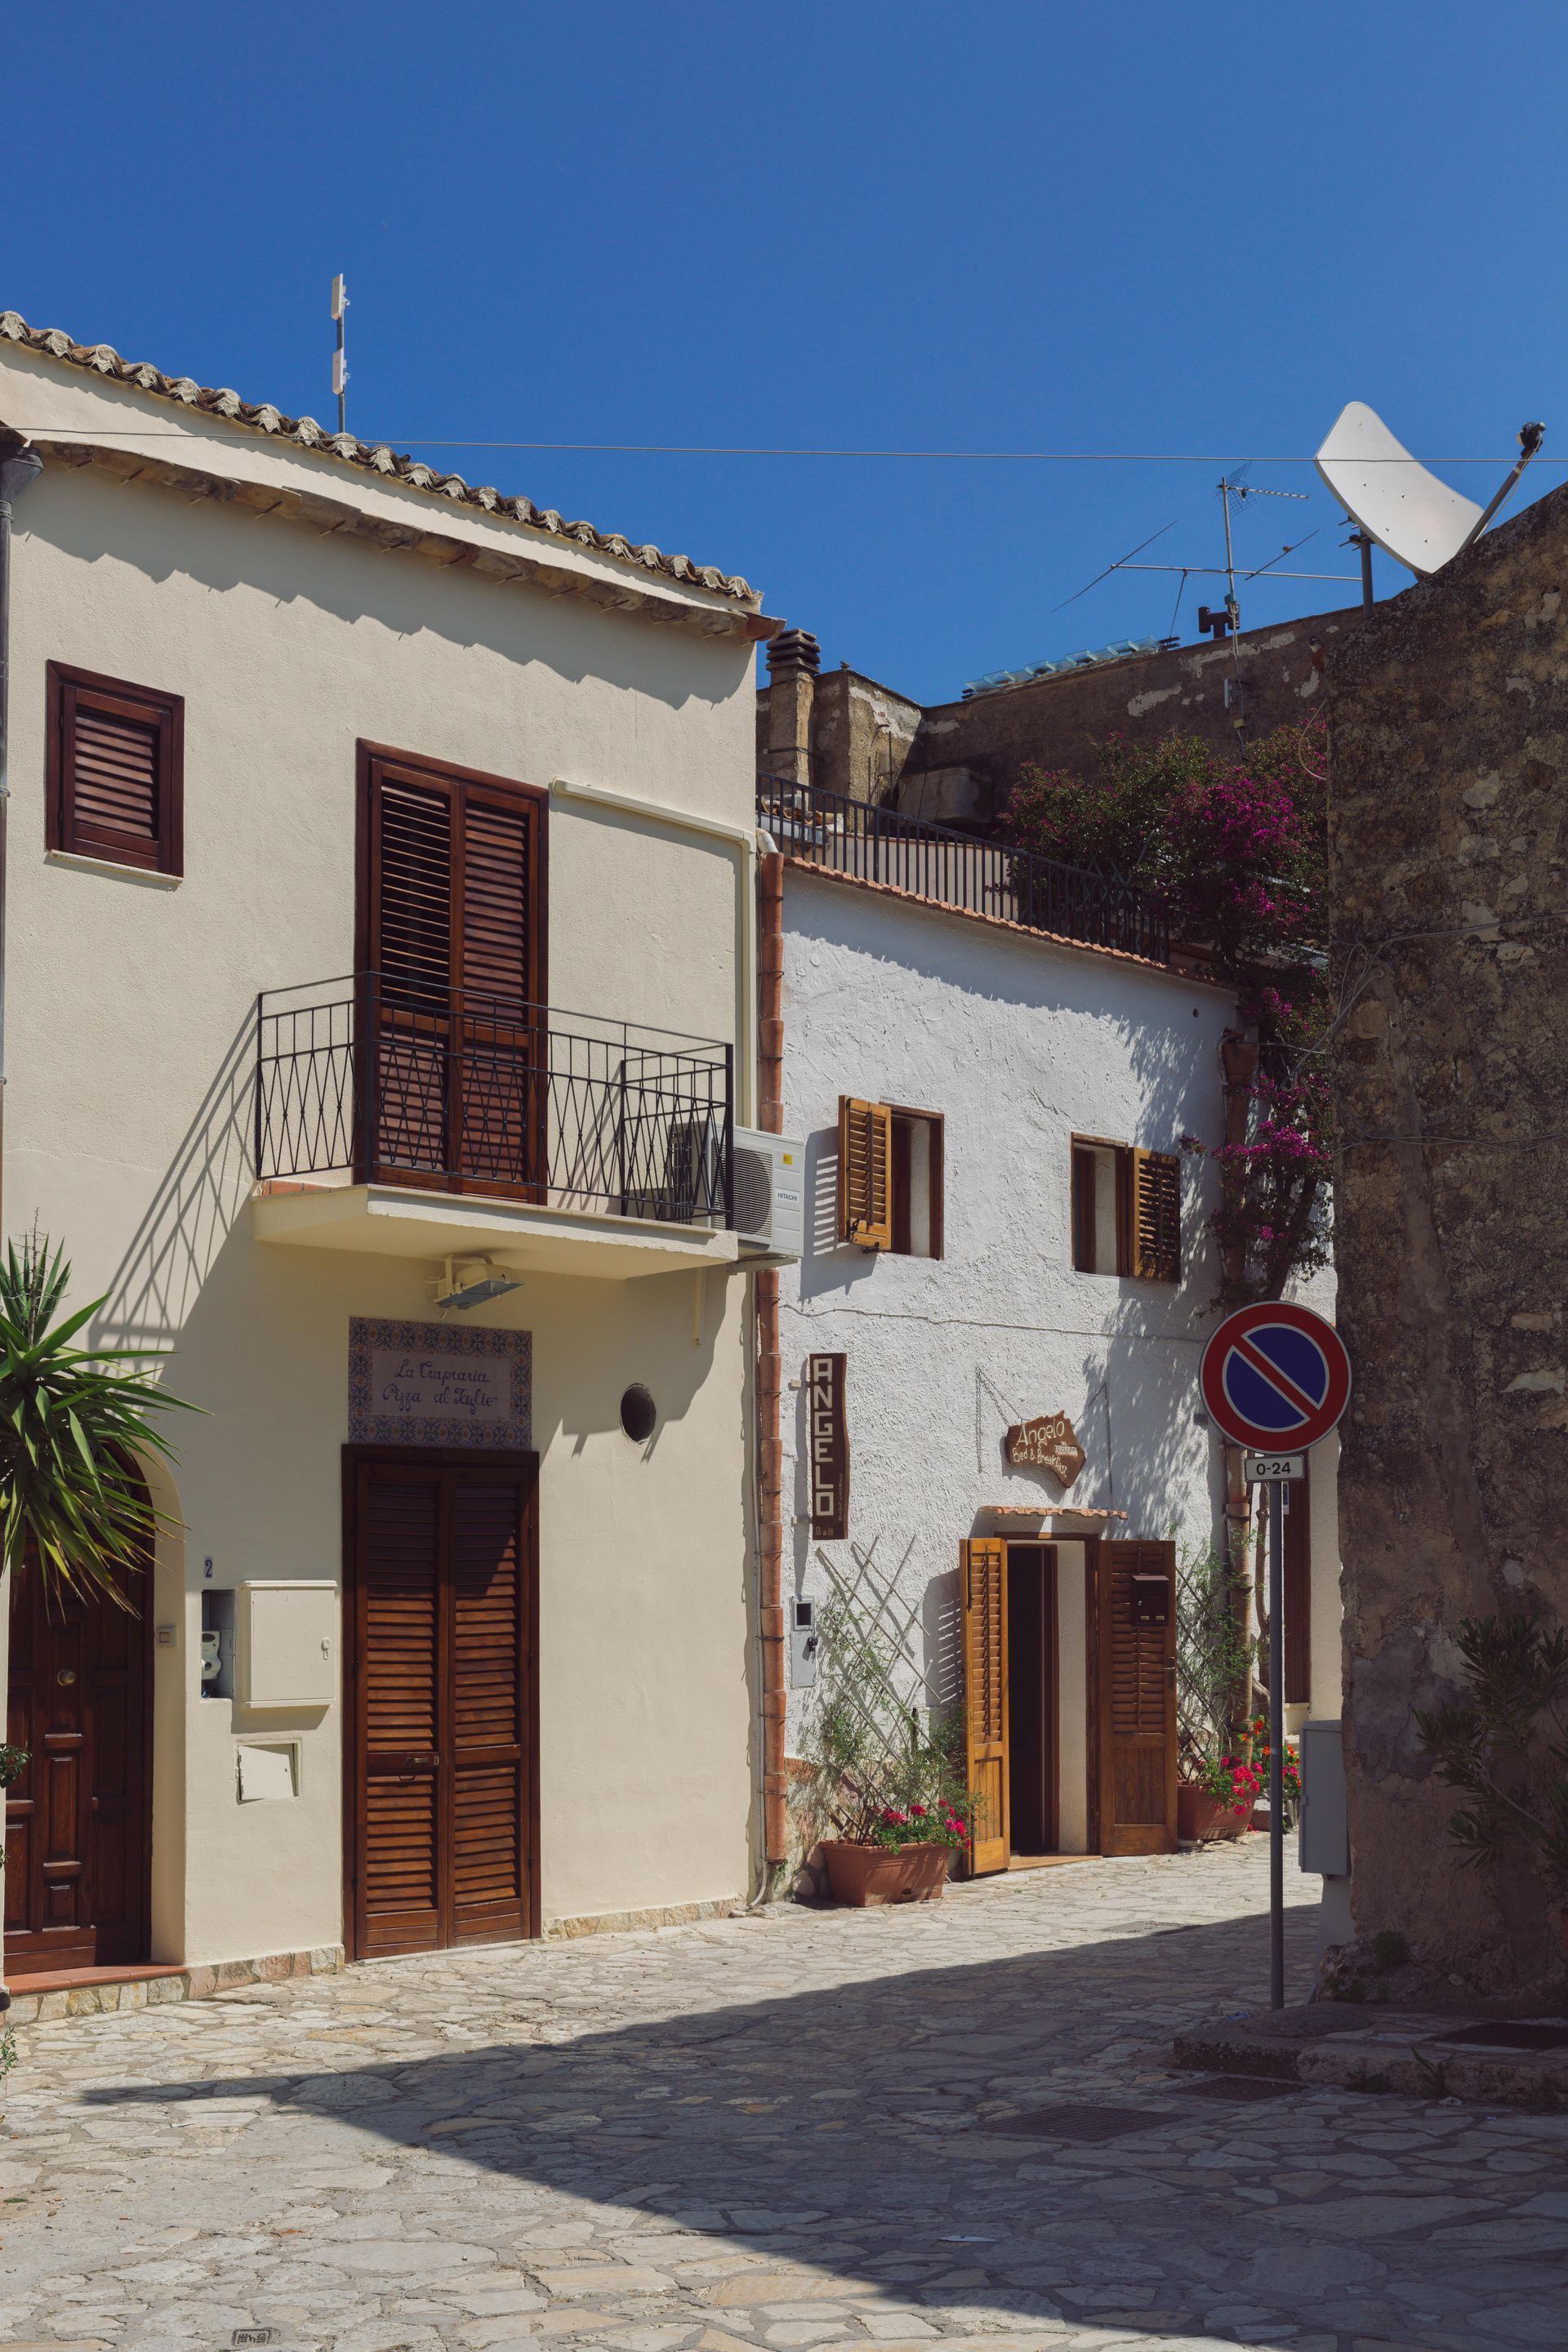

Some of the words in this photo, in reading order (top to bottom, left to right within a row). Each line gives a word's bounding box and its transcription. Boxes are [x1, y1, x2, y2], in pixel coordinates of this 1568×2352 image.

[777, 1192, 798, 1201] HITACHI
[393, 1358, 414, 1379] La
[382, 1383, 422, 1412] Pizza
[434, 1386, 449, 1404] al
[813, 1358, 835, 1517] ANGELO
[1016, 1419, 1065, 1448] Angelo
[1012, 1447, 1028, 1463] Bed
[1030, 1451, 1036, 1460] &
[1037, 1448, 1068, 1477] Breakfast
[1256, 1462, 1291, 1476] 0-24
[204, 1559, 213, 1578] 2
